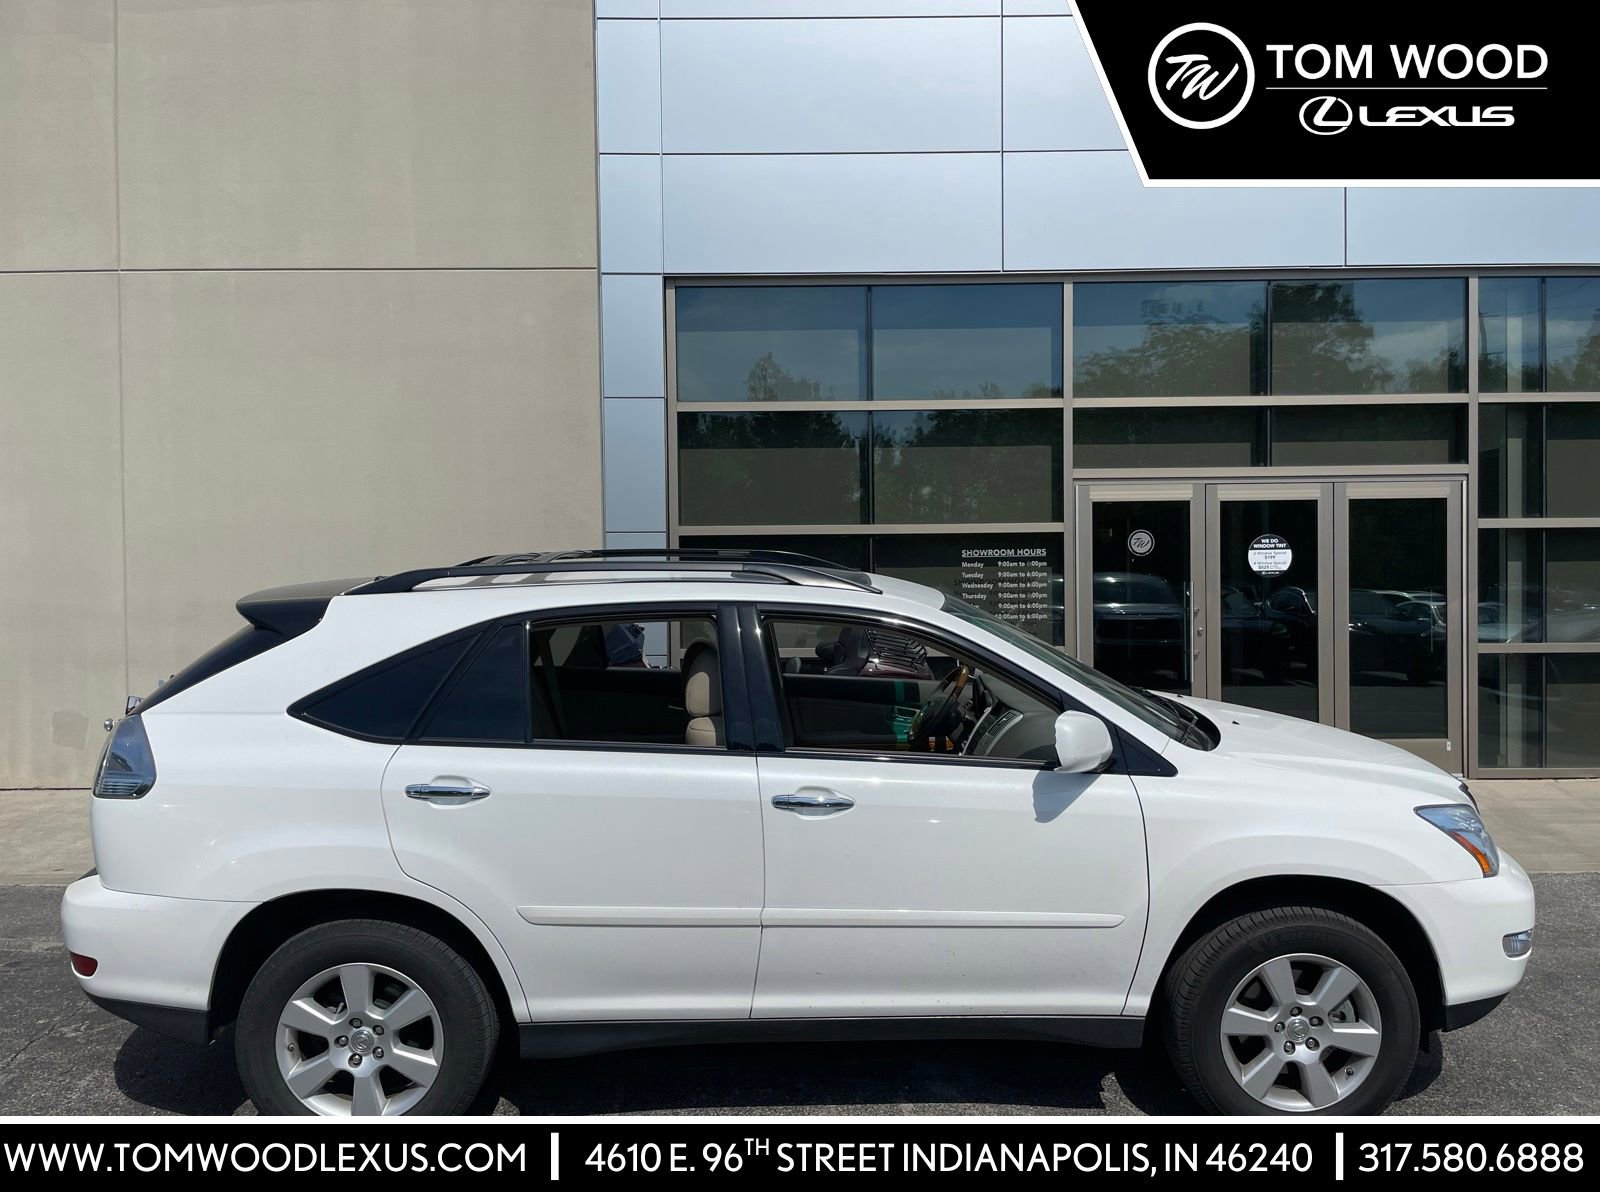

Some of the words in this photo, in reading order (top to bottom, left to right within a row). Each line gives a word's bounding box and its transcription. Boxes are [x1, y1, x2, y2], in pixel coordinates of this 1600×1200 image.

[961, 549, 1015, 557] SHOWROOM
[1017, 548, 1047, 557] HOURS
[961, 561, 984, 569] Monday
[961, 571, 984, 579] Tuesday
[961, 582, 993, 590] Wednesday
